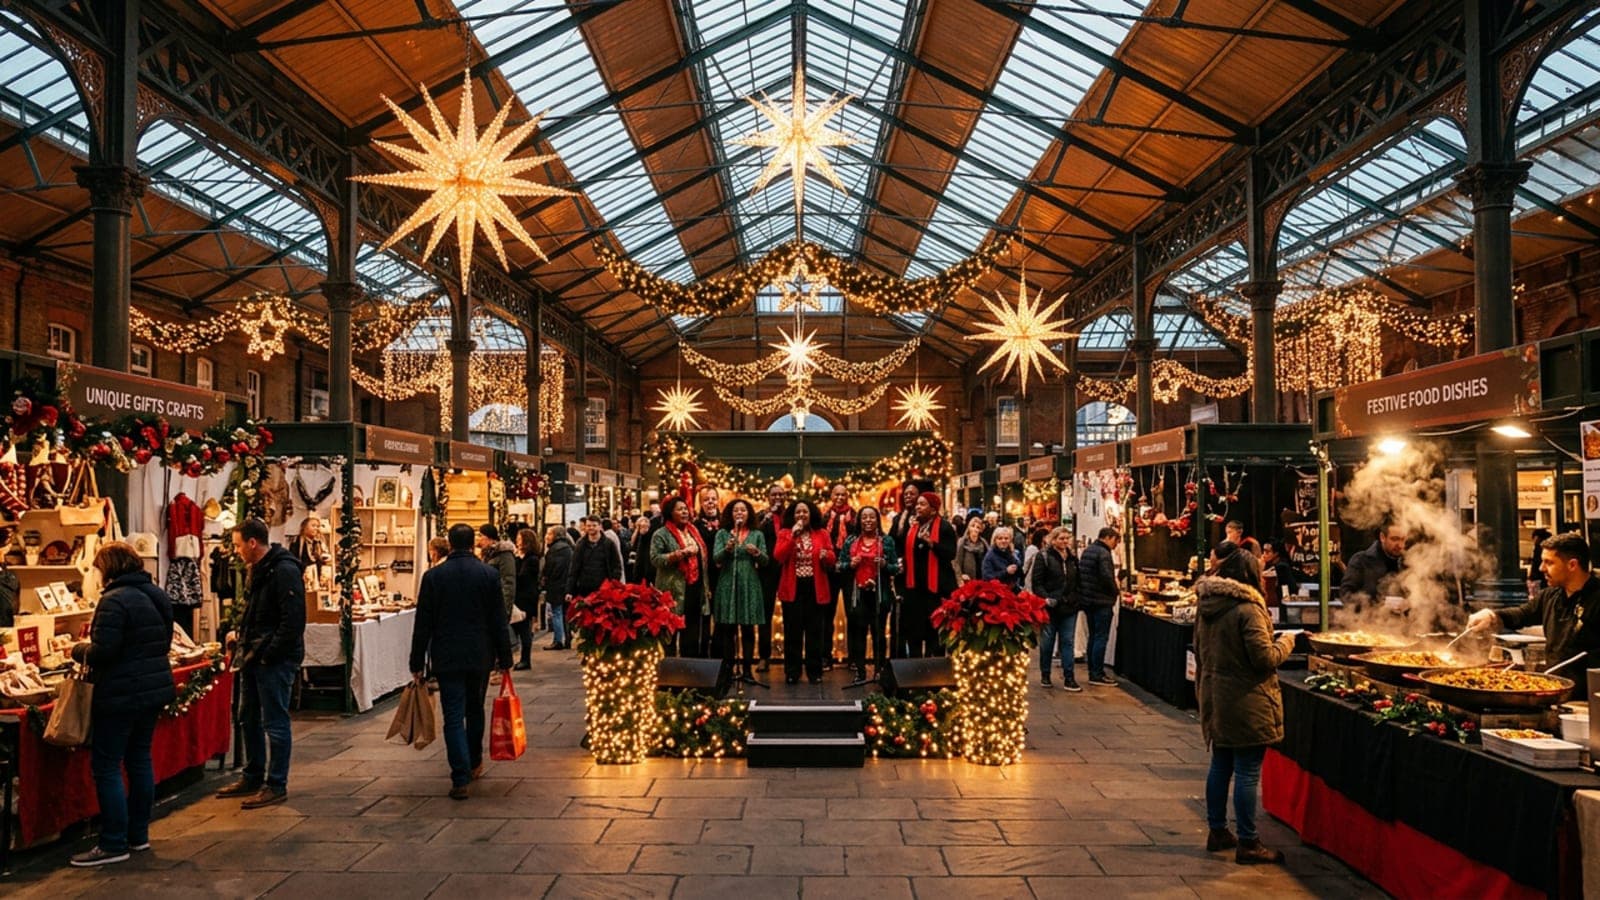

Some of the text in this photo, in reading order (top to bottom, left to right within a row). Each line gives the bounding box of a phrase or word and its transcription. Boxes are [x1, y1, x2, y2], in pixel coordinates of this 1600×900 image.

[86, 386, 204, 420] UNIQUE GIFTS CRAFTS
[1367, 377, 1488, 415] FESTIVE FOOD DISHES
